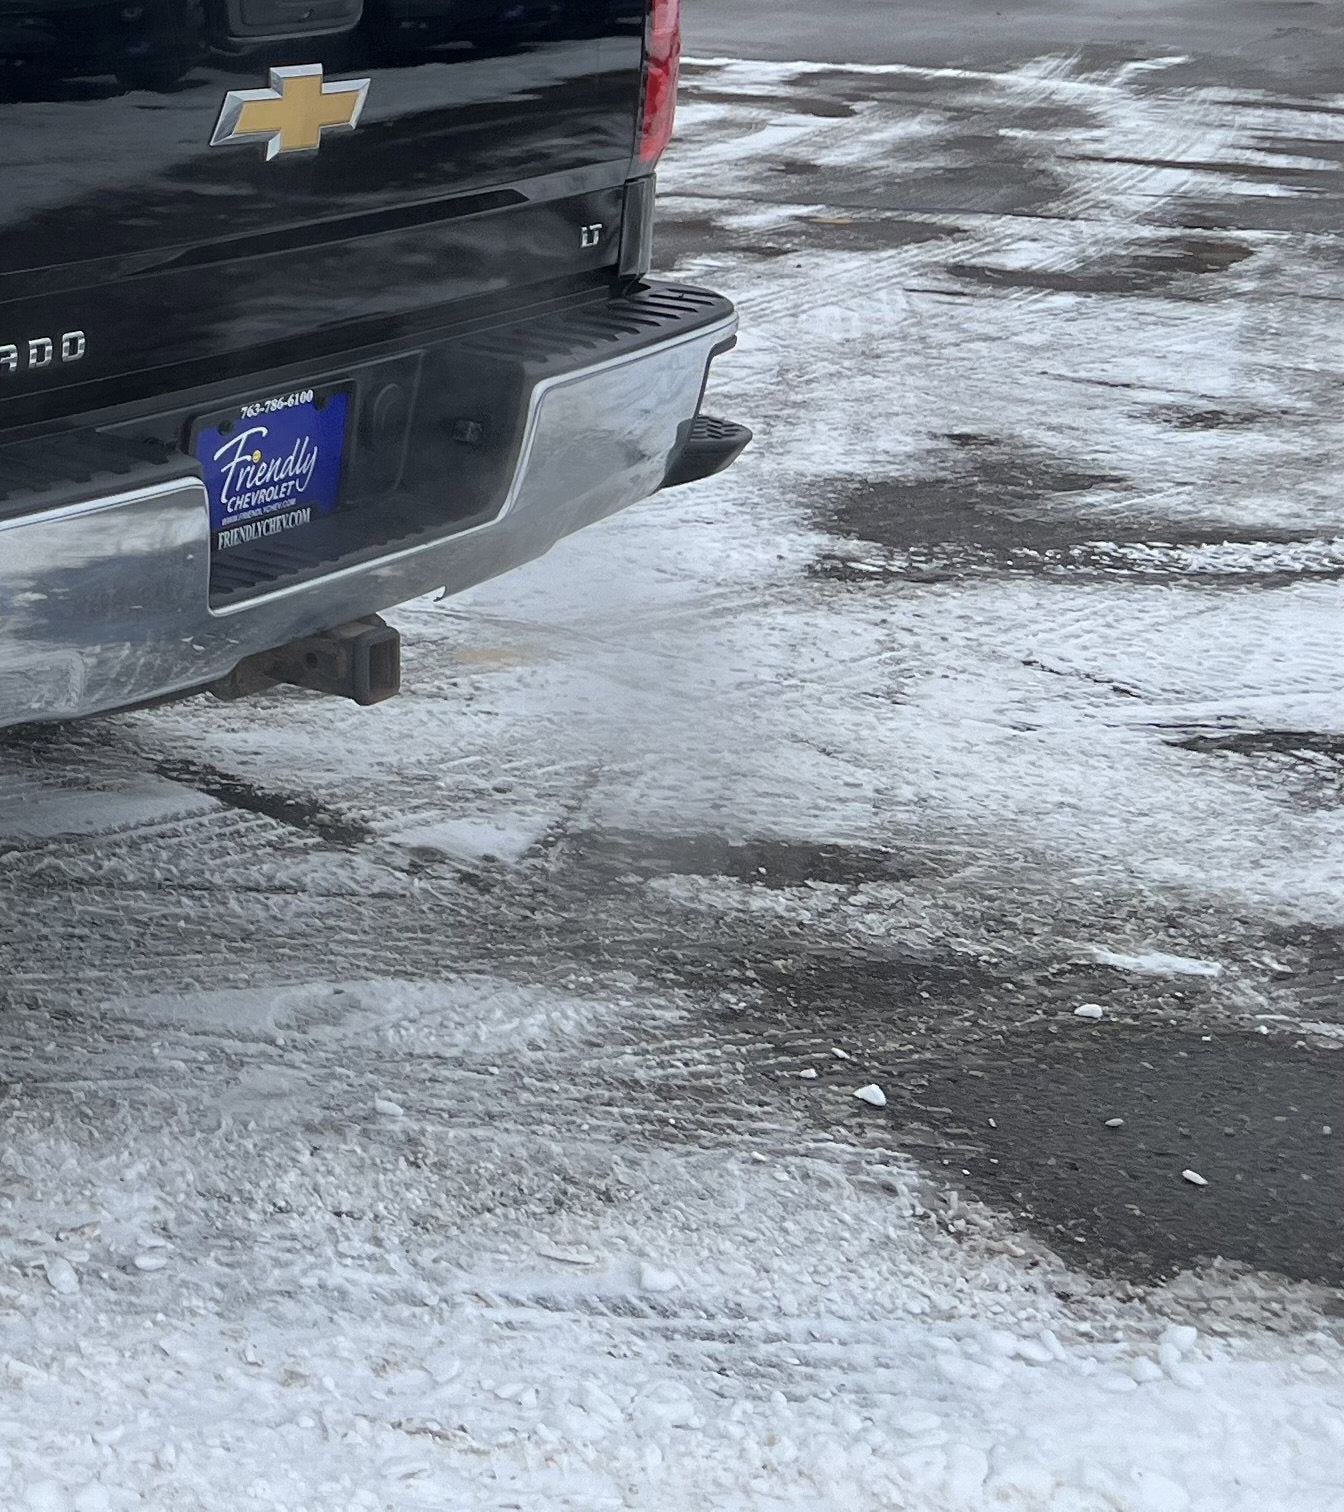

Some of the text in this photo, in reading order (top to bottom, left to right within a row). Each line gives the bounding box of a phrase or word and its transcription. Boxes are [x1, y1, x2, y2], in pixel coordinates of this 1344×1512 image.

[580, 223, 603, 248] LT
[240, 389, 314, 420] 763-786-6100
[213, 426, 318, 503] Friendly
[227, 480, 295, 513] CHEVROLET
[218, 507, 312, 551] FRIENDLYCHEV.COM
